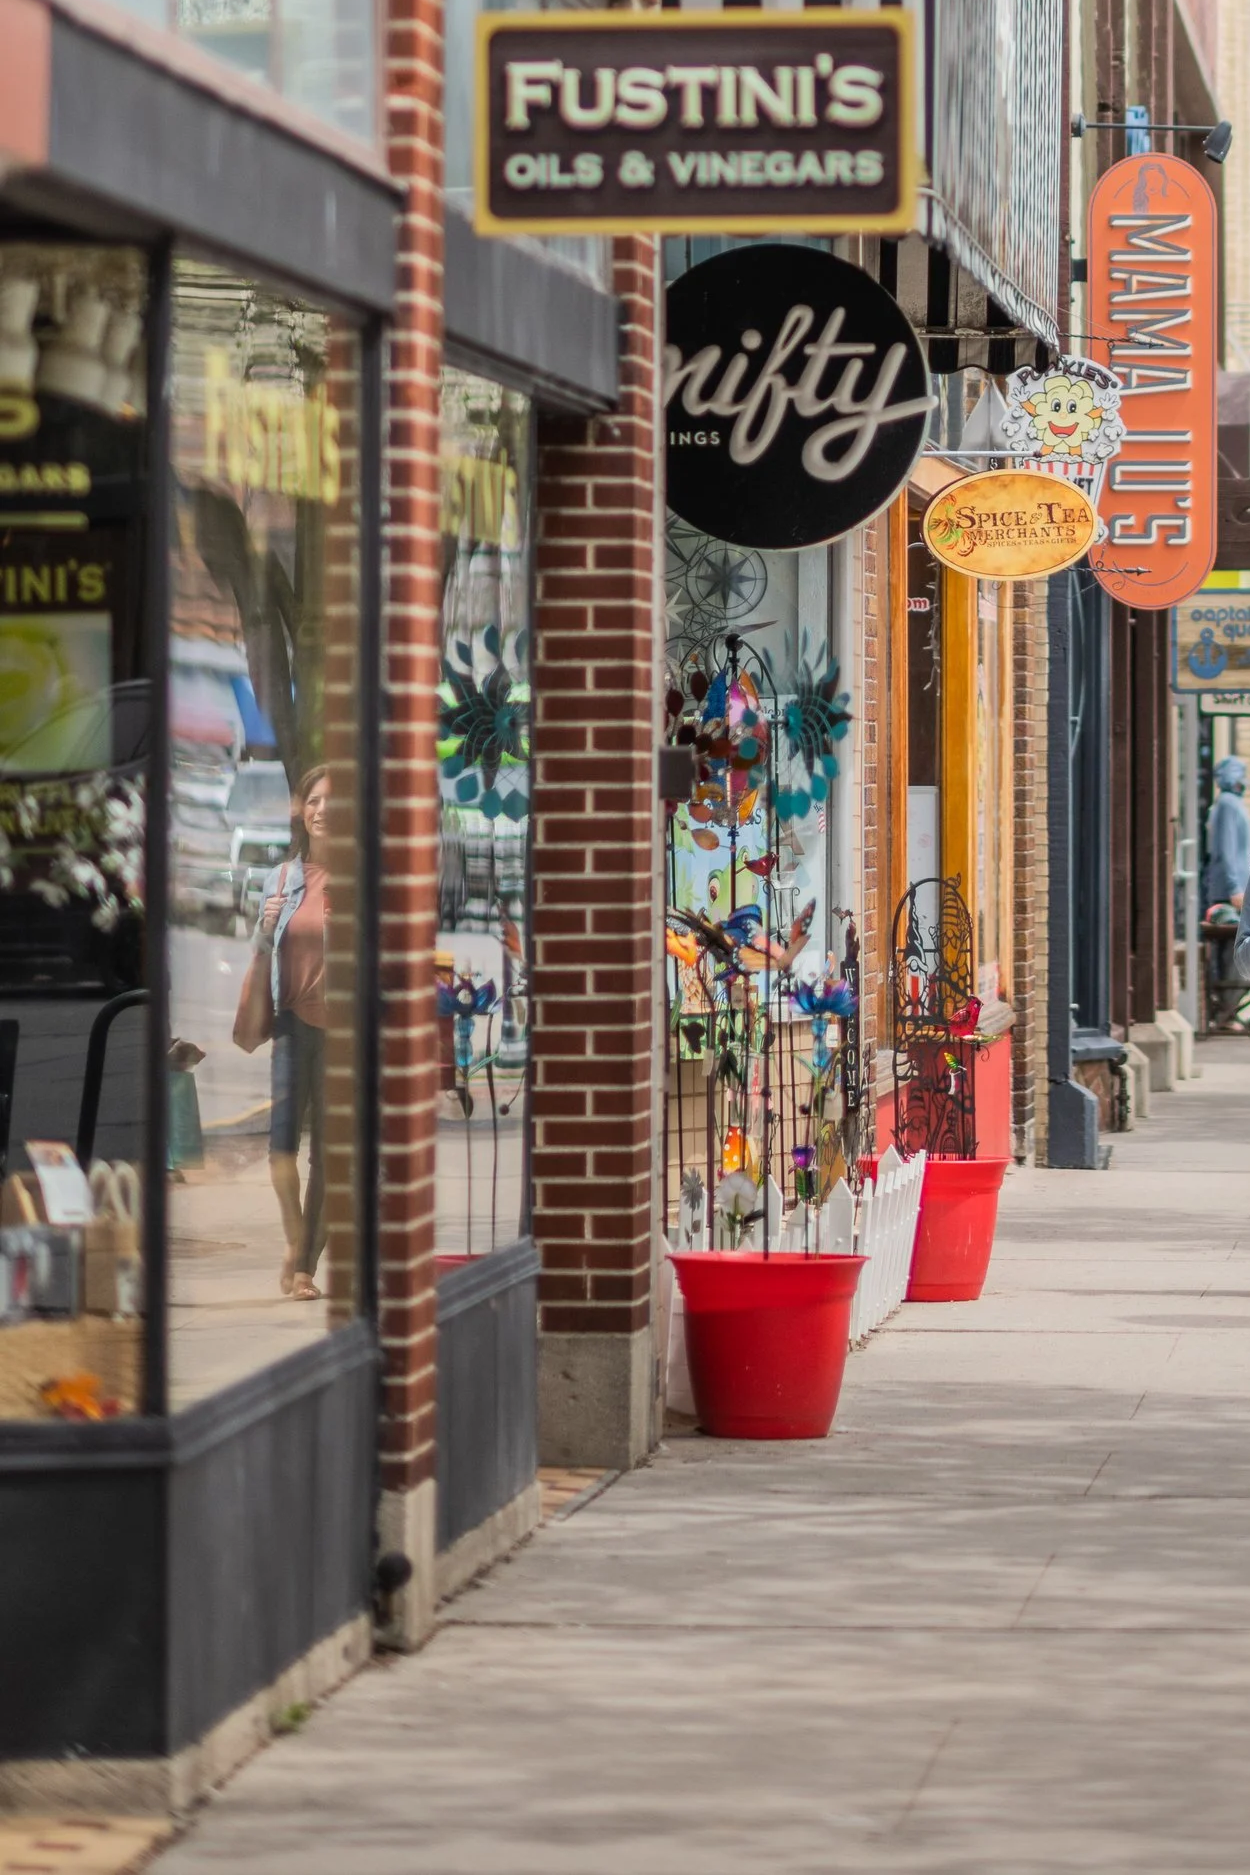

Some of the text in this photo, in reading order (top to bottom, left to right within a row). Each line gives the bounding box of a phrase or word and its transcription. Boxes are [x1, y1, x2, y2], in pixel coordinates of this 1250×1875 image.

[505, 52, 884, 129] FUSTINI'S
[504, 149, 884, 189] OILS & VINEGARS
[1108, 213, 1193, 395] MAMA
[666, 303, 939, 481] nifty
[669, 430, 721, 446] INGS
[956, 502, 1091, 530] SPICE & TEA
[968, 525, 1077, 541] MERCHANTS
[0, 558, 107, 606] INI'S
[844, 968, 856, 1108] WCOME
